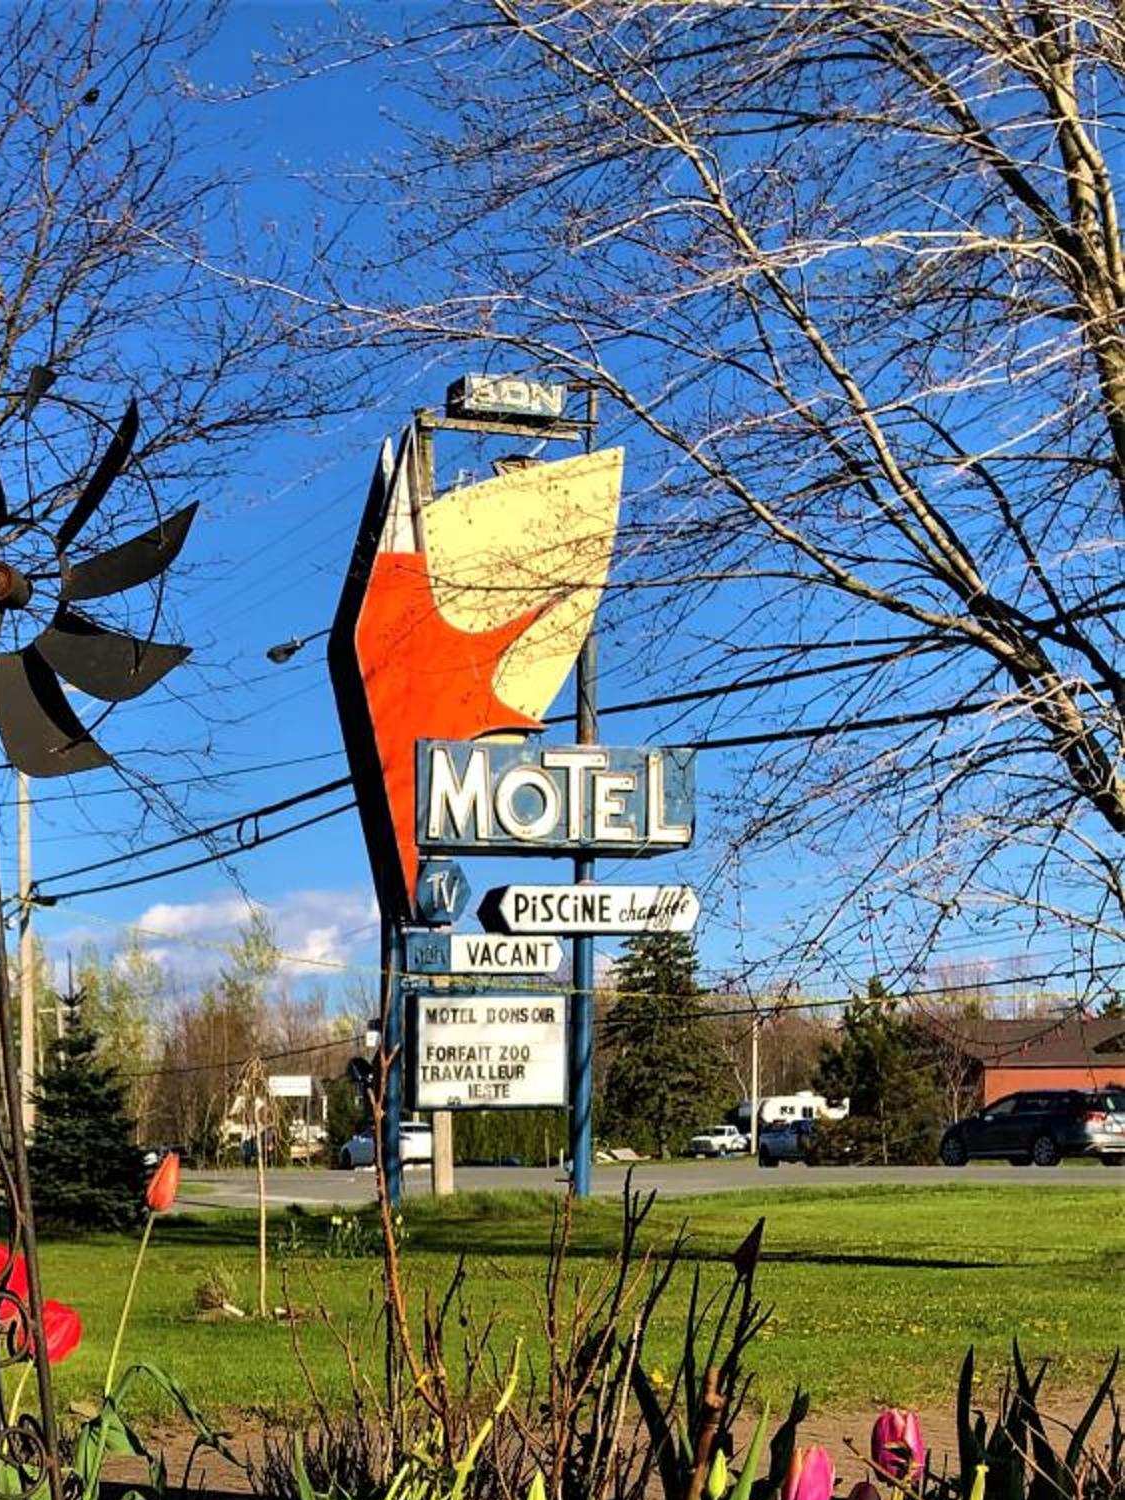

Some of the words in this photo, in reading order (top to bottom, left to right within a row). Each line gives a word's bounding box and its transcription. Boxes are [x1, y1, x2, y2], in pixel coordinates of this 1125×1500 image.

[428, 748, 691, 843] MOTEL
[426, 868, 460, 913] TV
[466, 942, 554, 967] VACANT
[426, 1007, 478, 1025] MOTEL
[426, 1045, 492, 1062] FORFAIT
[499, 1044, 531, 1062] ZOO
